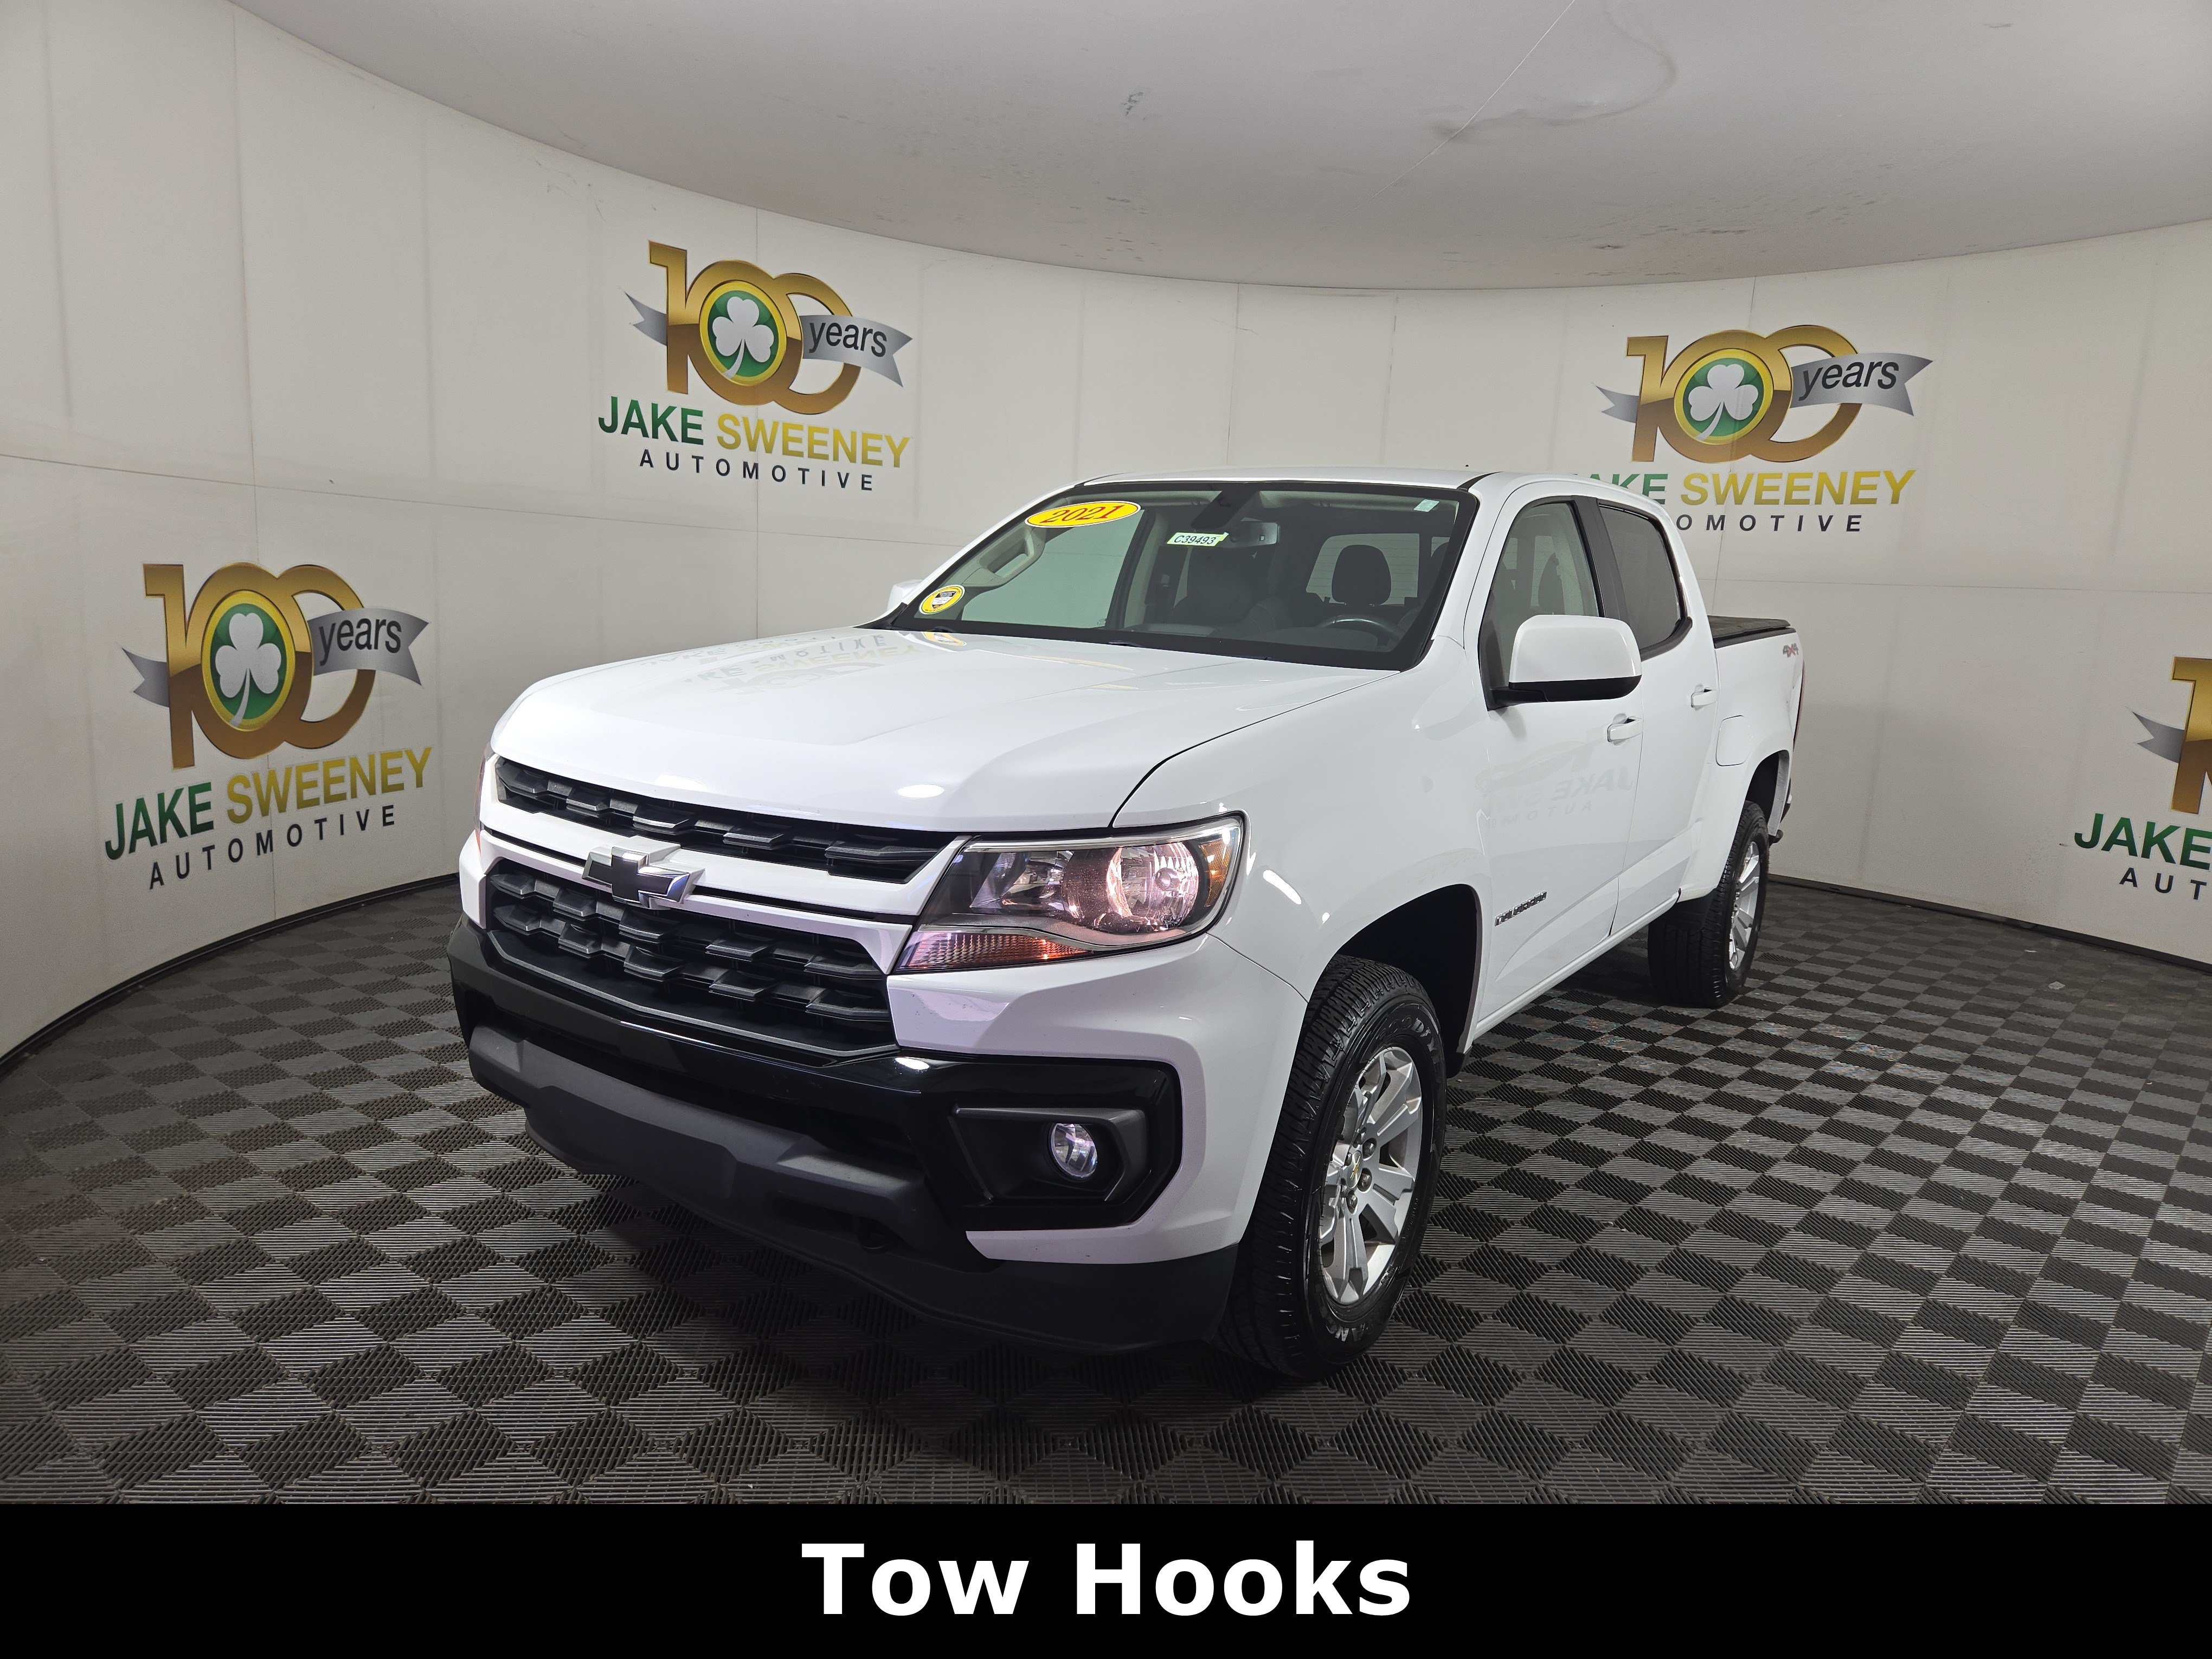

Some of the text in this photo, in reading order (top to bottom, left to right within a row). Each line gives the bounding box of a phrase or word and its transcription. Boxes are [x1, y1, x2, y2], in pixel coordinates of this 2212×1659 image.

[648, 240, 888, 415] 100 years
[1626, 325, 1899, 464] 100 years
[598, 396, 910, 468] JAKE SWEENEY
[640, 449, 872, 491] AUTOMOTIVE
[1572, 470, 1917, 506] KE SWEENEY
[1039, 504, 1126, 524] 2021
[1174, 535, 1217, 545] C39493
[1676, 514, 1863, 532] OMOTIVE
[143, 562, 402, 770] 100 years
[105, 747, 432, 860] JAKE SWEENEY
[149, 805, 395, 890] AUTOMOTIVE
[2074, 813, 2212, 871] JAKE
[2119, 867, 2208, 900] AUT
